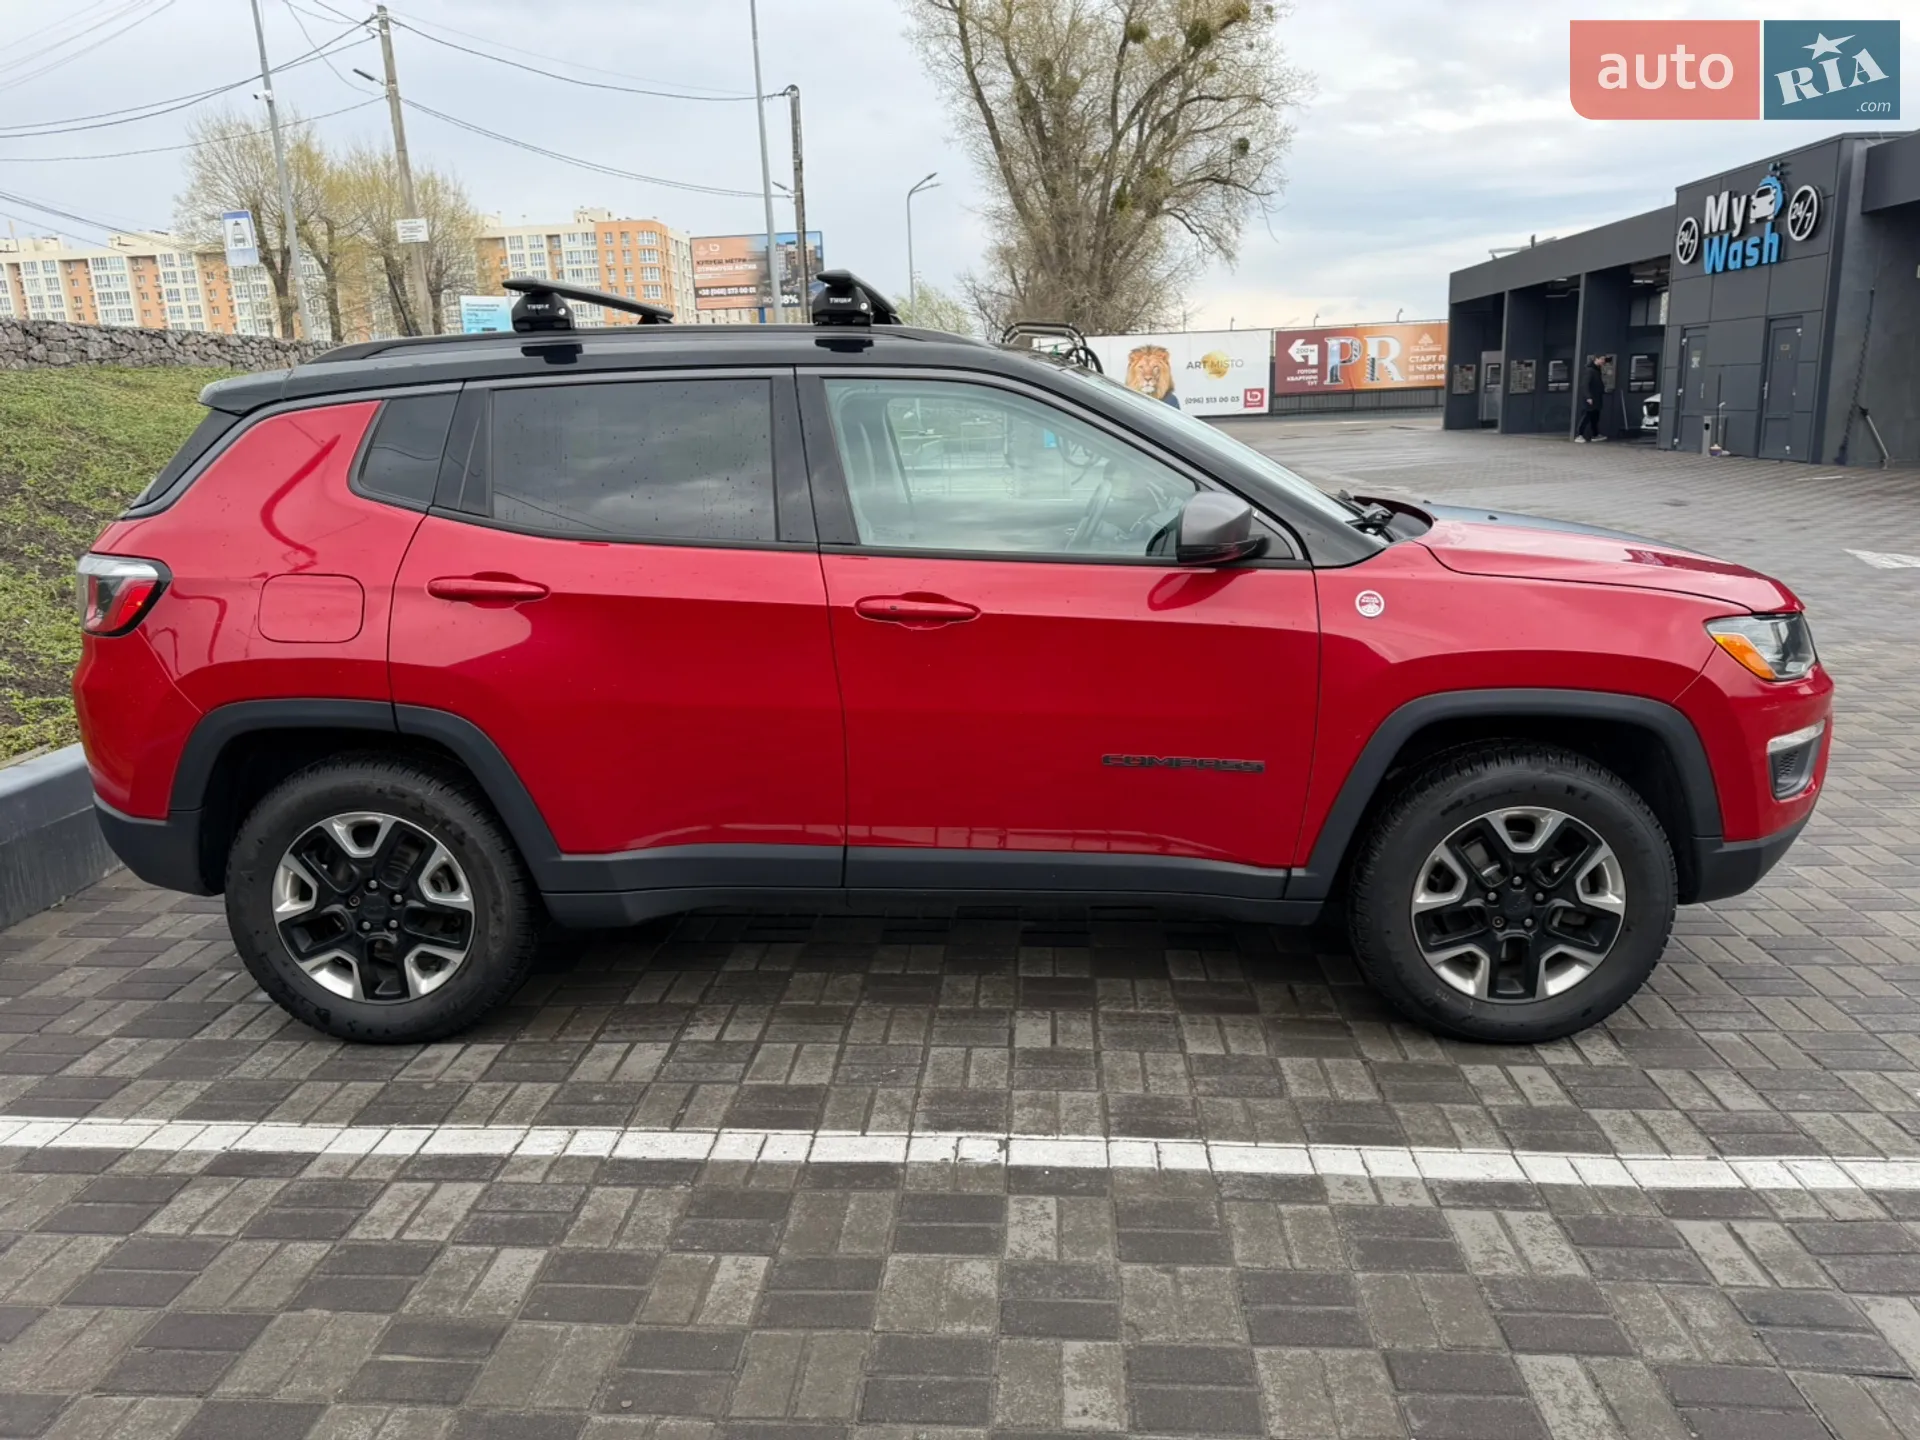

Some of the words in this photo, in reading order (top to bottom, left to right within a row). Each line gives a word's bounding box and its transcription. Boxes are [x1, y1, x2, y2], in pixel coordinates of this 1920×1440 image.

[1704, 190, 1747, 238] My
[1789, 194, 1814, 236] 24/7
[1678, 225, 1696, 261] 24/7
[1703, 221, 1780, 275] Wash
[1186, 361, 1208, 370] ART
[1210, 358, 1244, 369] MISTO
[1296, 347, 1309, 355] 200
[1323, 335, 1405, 385] PR
[1409, 355, 1438, 363] СТАРТ
[1185, 396, 1204, 405] (096)
[1102, 753, 1265, 773] COMPASS
